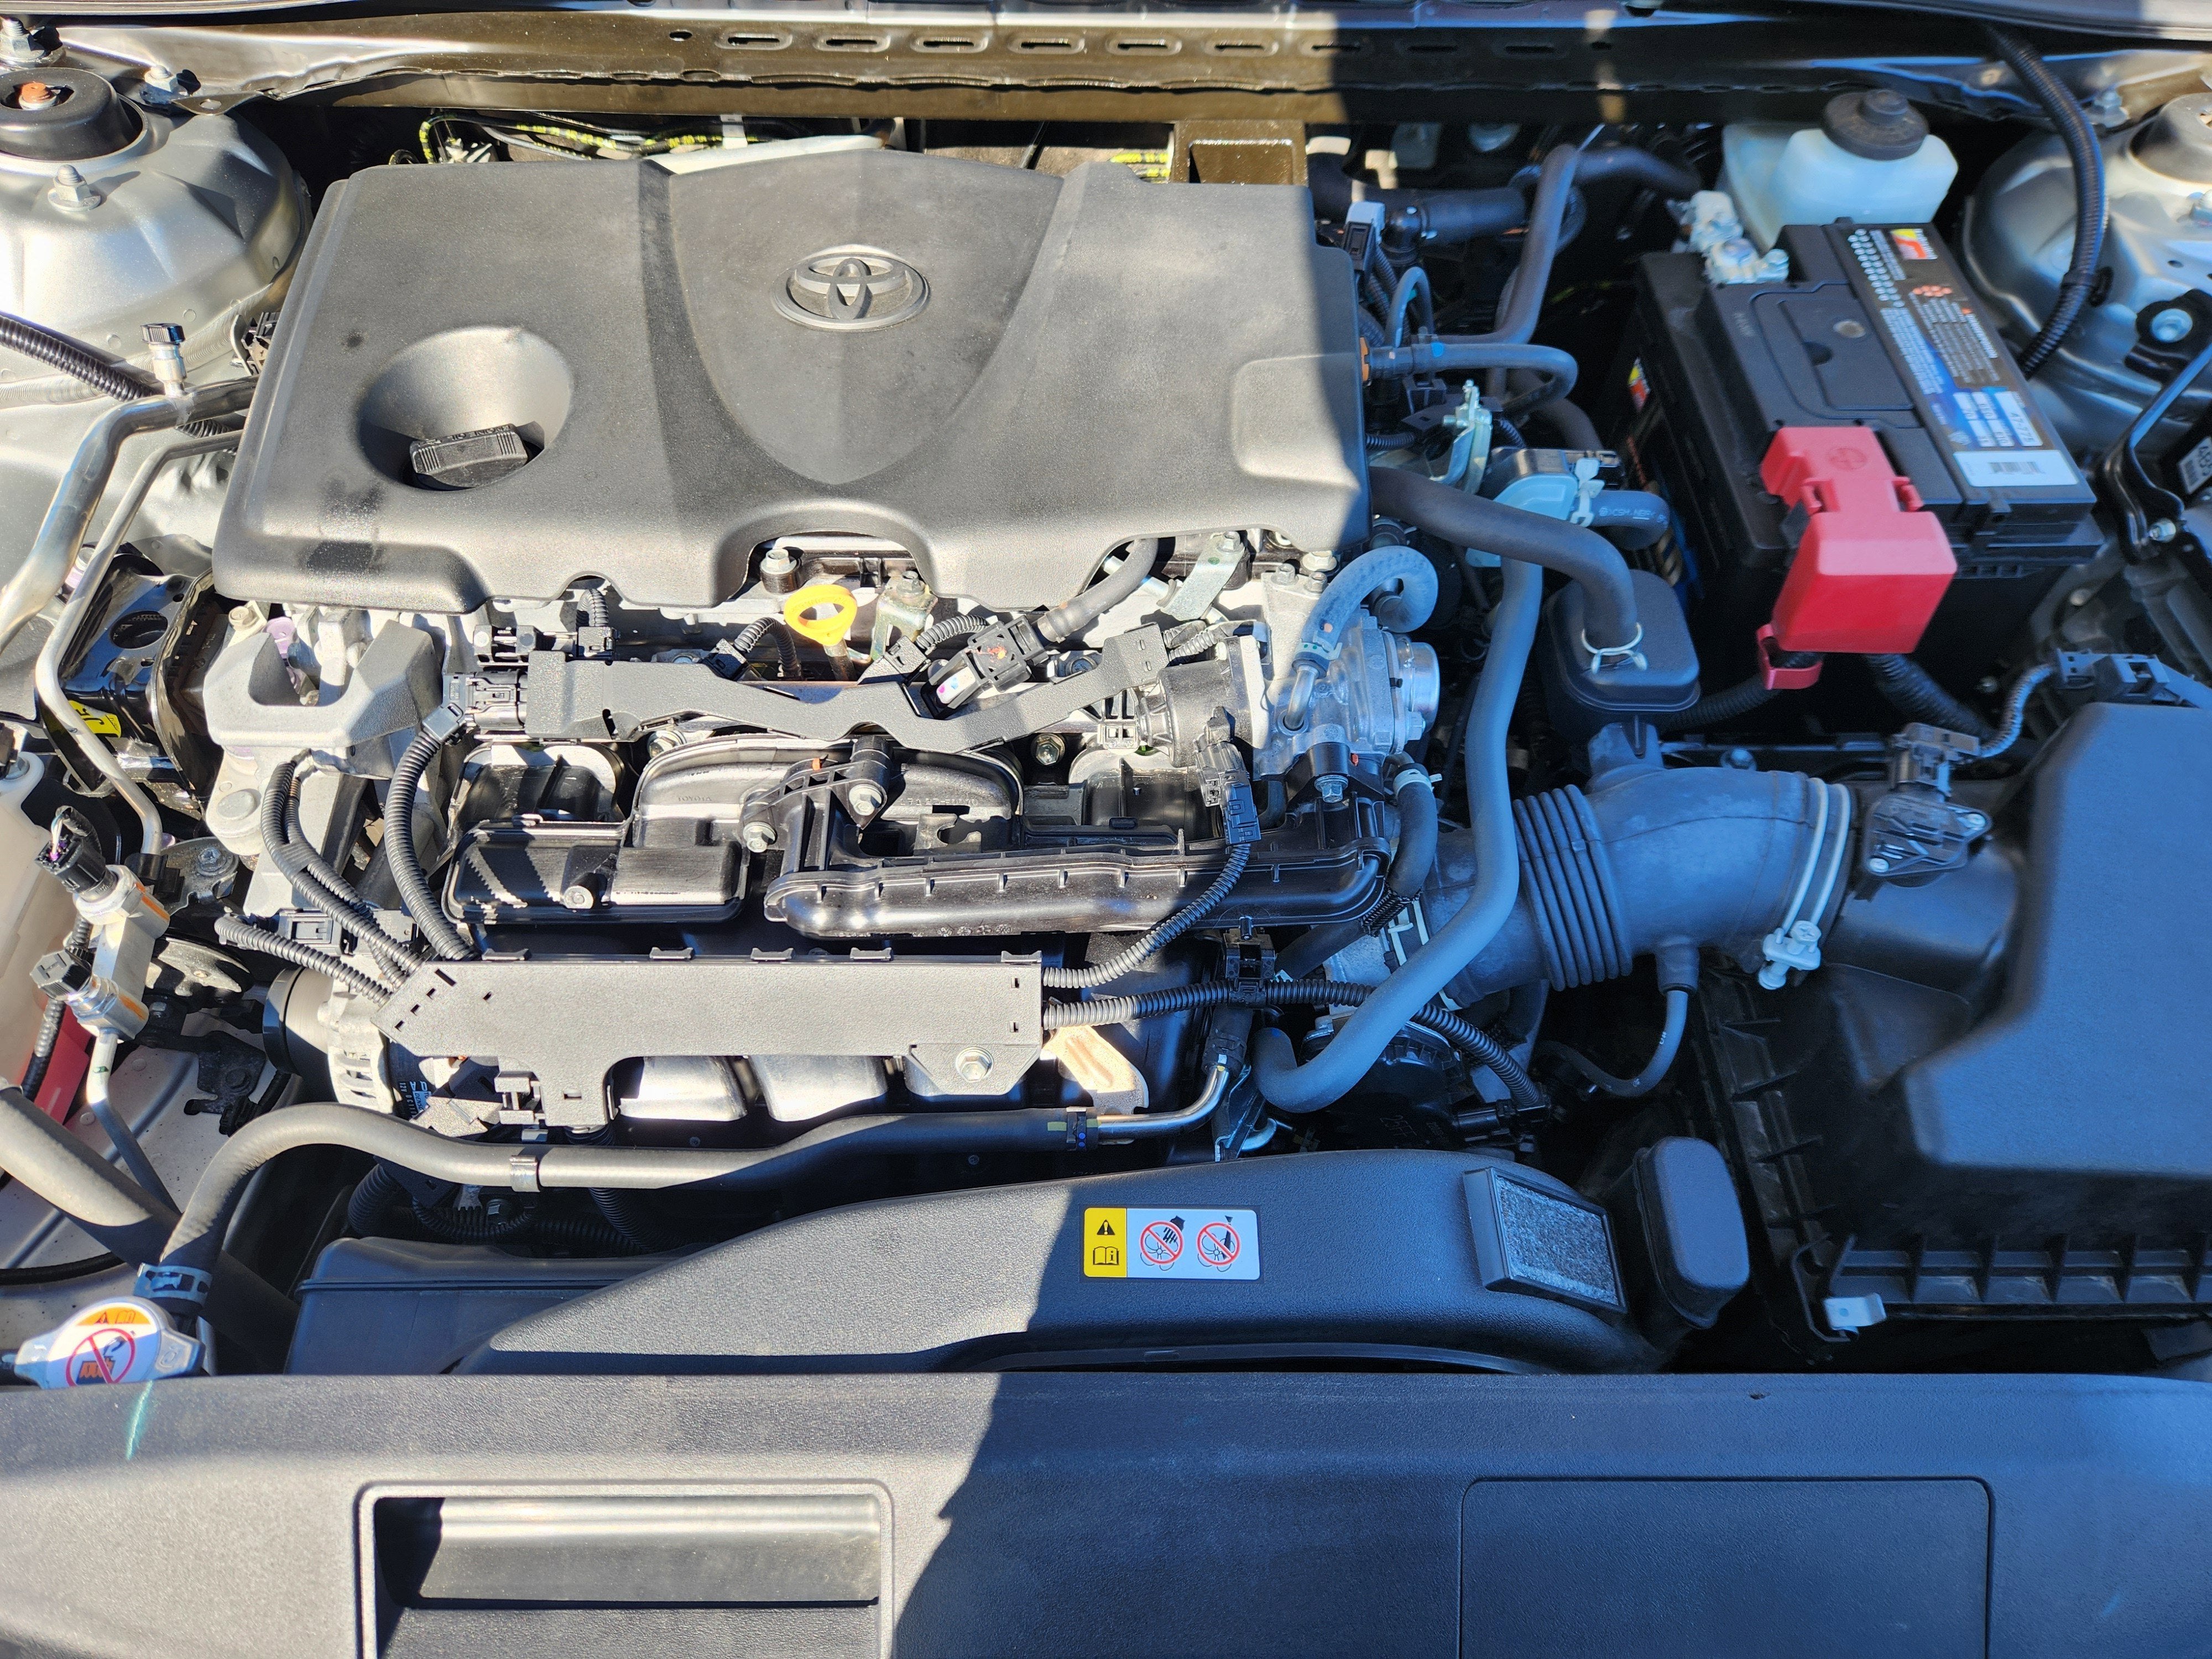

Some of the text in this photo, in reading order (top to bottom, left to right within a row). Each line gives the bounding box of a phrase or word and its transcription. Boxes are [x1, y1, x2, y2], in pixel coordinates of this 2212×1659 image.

[447, 425, 511, 441] ENGINE OIL
[399, 1082, 408, 1092] 12V
